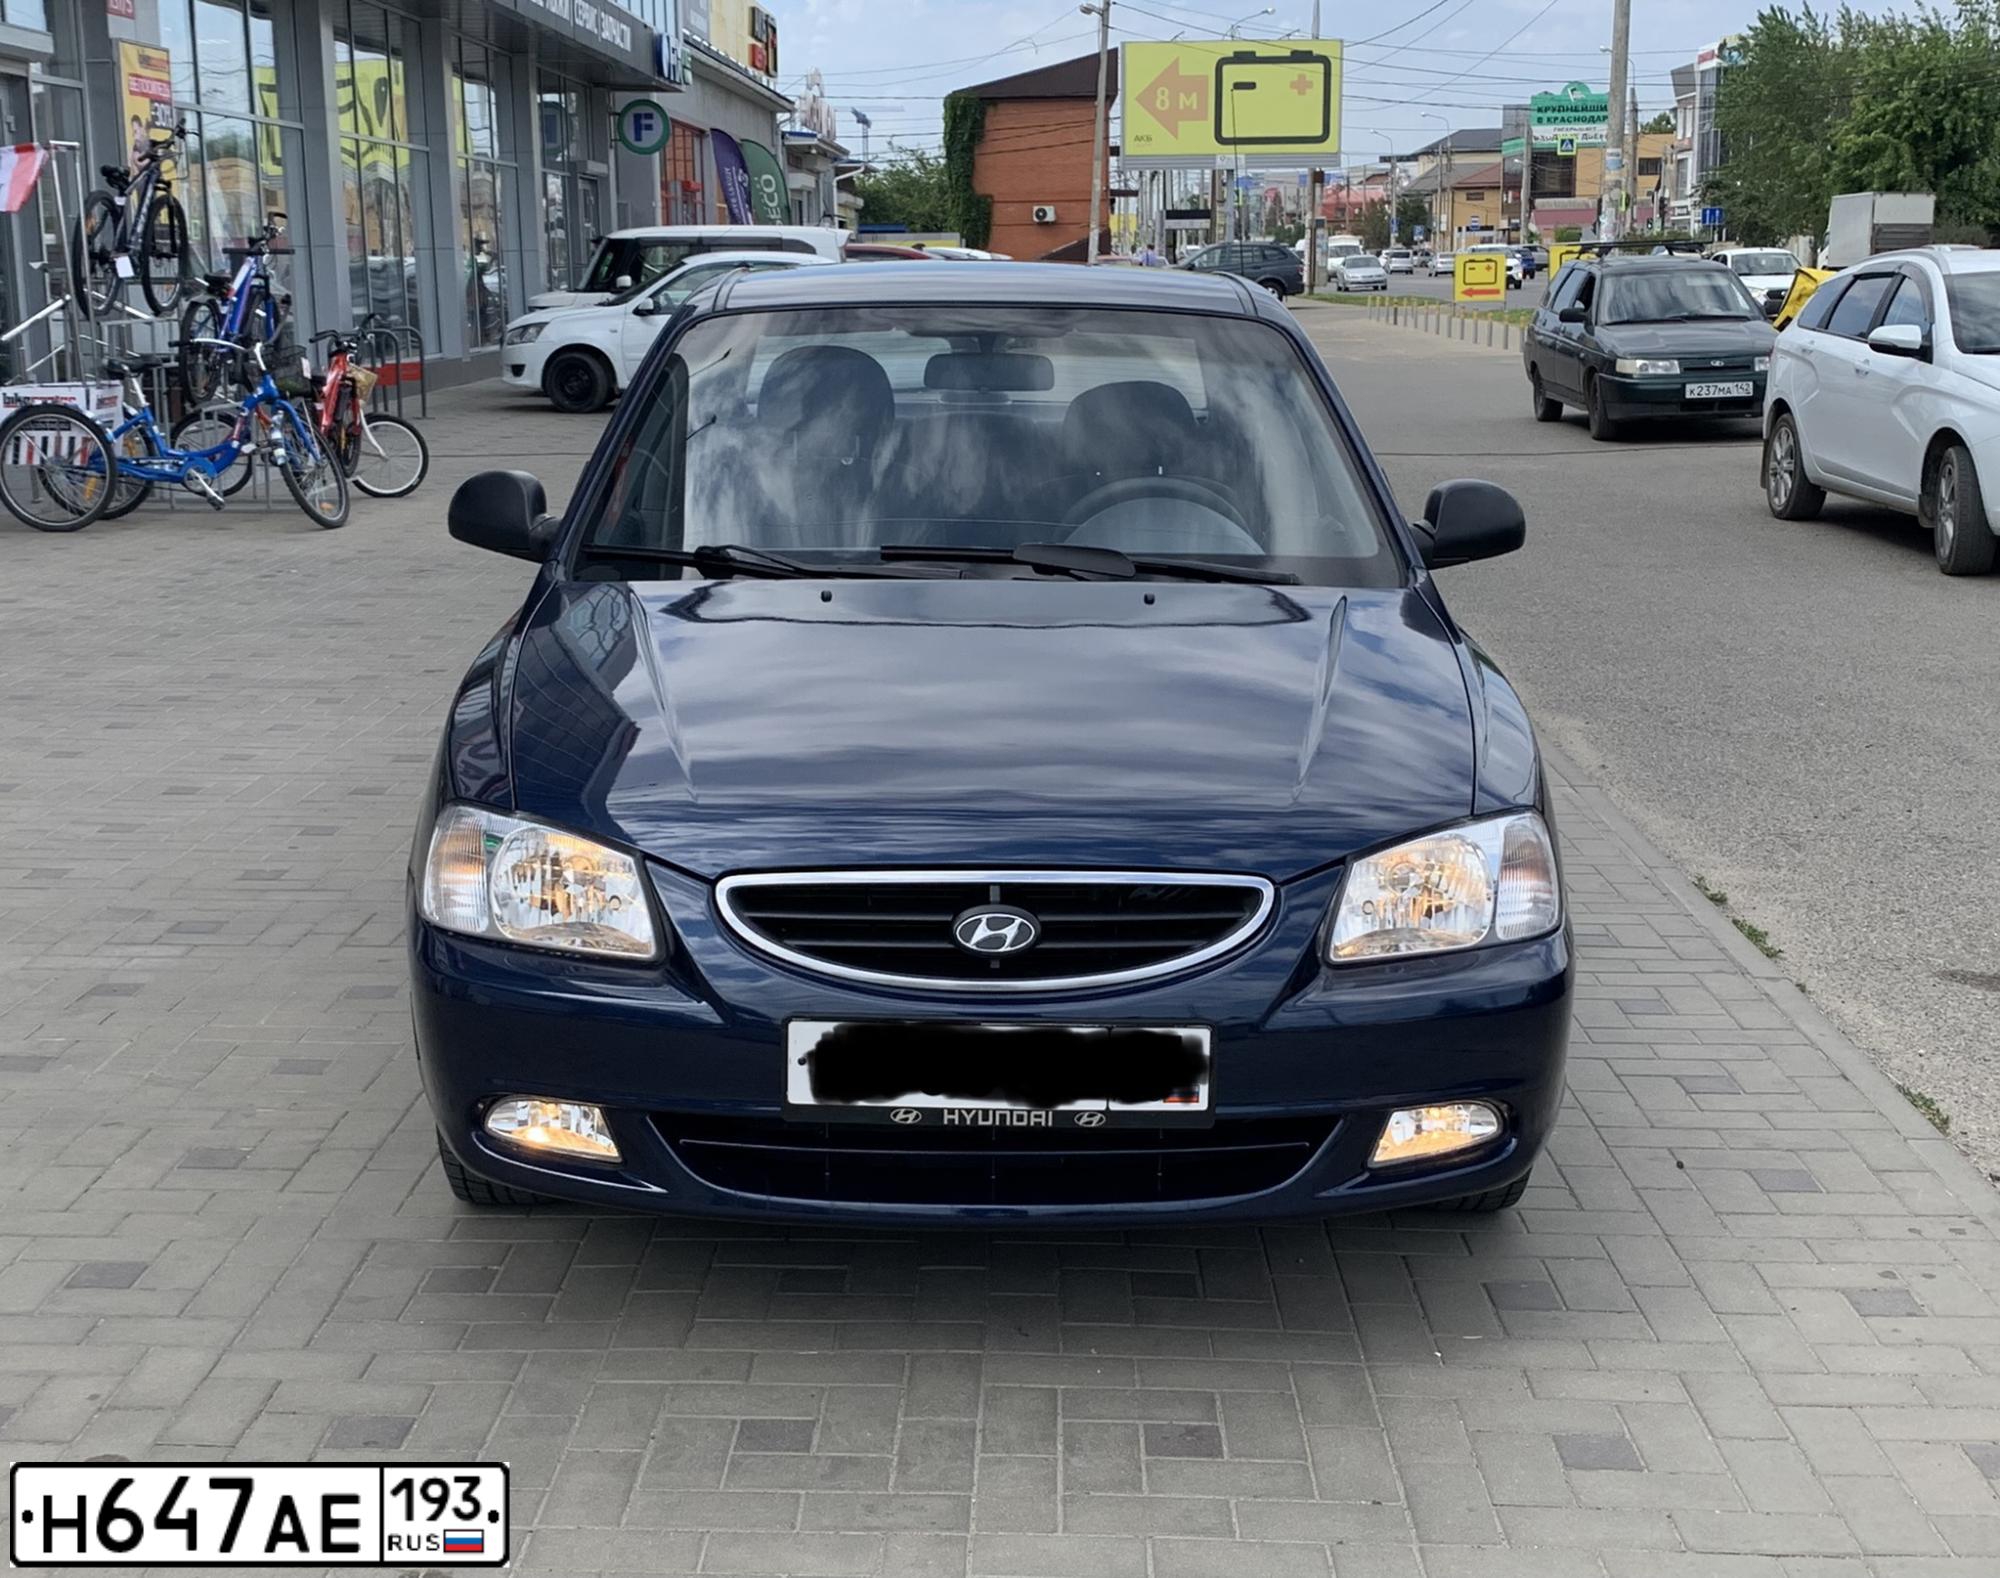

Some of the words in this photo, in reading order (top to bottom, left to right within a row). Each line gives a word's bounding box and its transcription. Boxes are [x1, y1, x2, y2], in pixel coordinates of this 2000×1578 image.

[1156, 87, 1170, 111] 8
[1179, 92, 1198, 110] М
[1537, 103, 1608, 113] КРУПНЕЙШИ
[633, 112, 654, 142] F
[1547, 115, 1608, 124] КРАСНОДАР
[1689, 384, 1732, 396] К237МА
[1735, 383, 1750, 392] 142
[943, 1109, 1053, 1126] HYUNDAI
